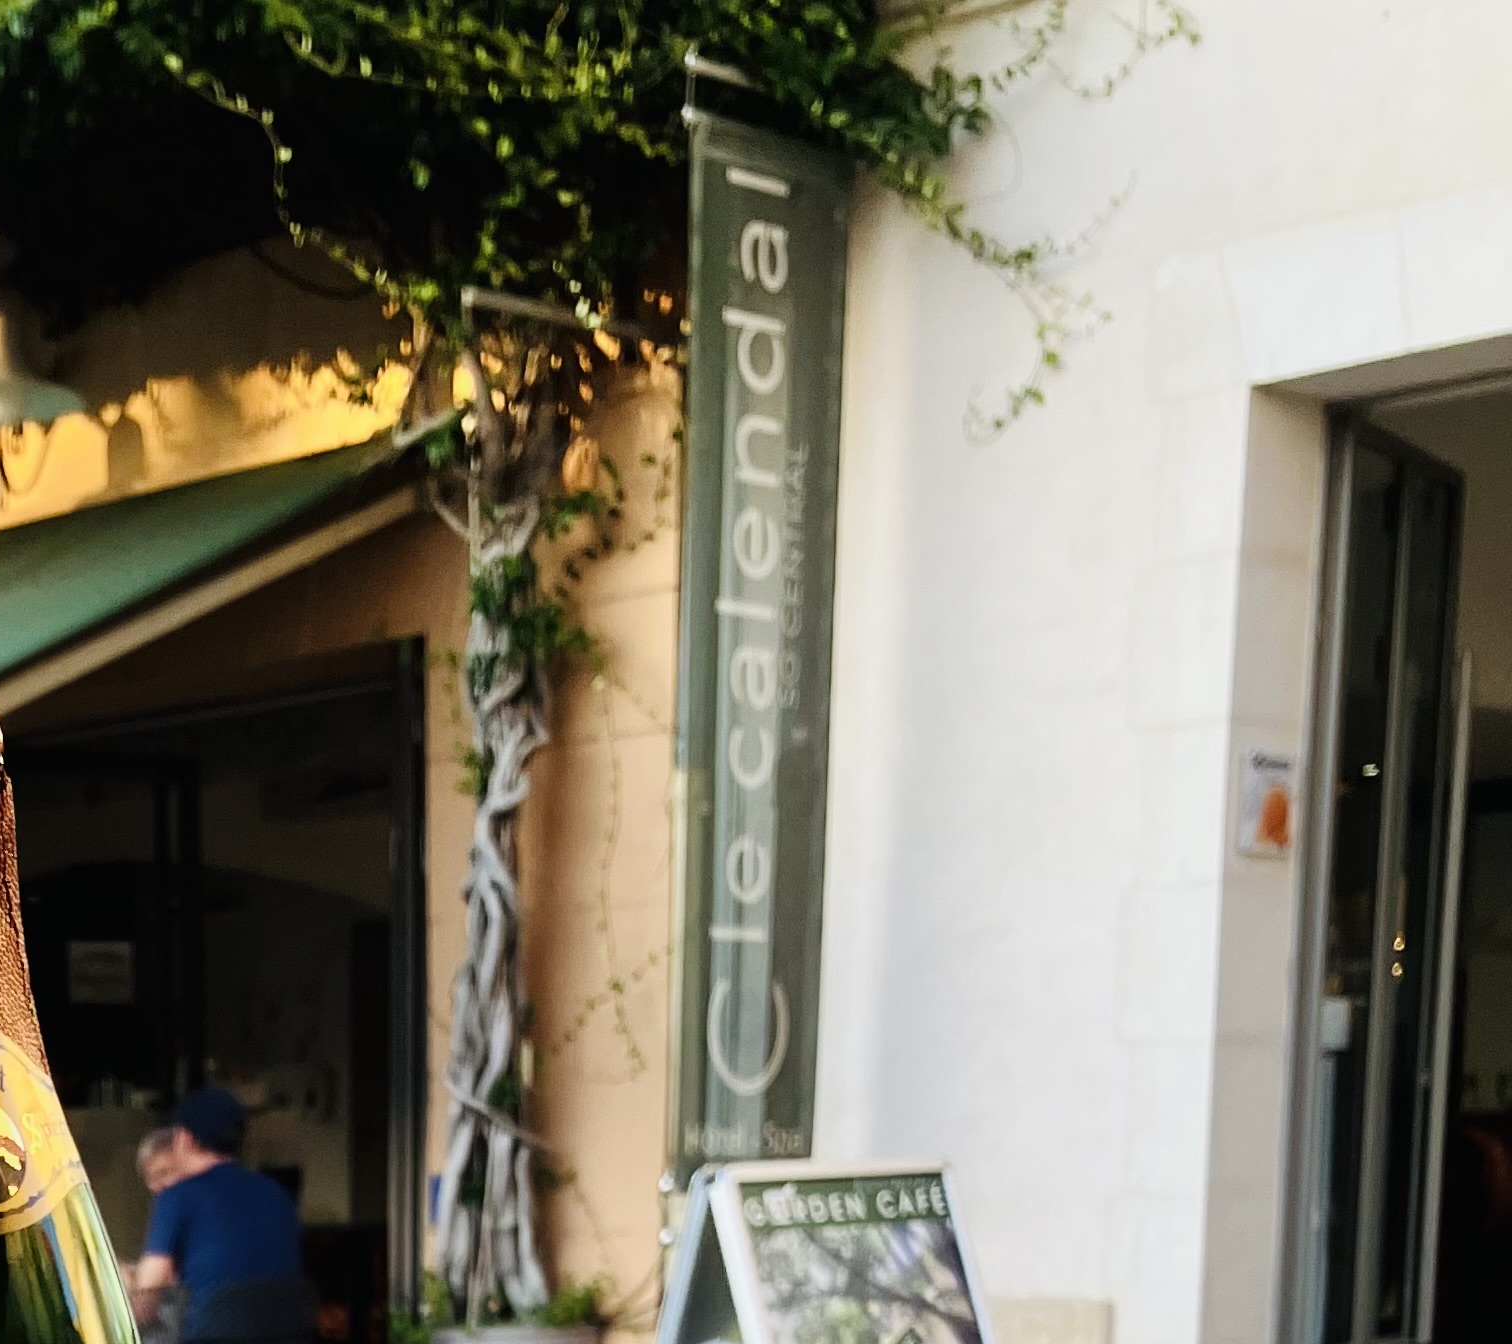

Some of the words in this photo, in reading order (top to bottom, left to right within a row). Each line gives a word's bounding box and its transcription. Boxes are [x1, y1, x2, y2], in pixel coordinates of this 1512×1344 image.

[715, 166, 791, 791] calendal
[708, 832, 772, 944] le
[876, 1180, 948, 1219] CAFÉ
